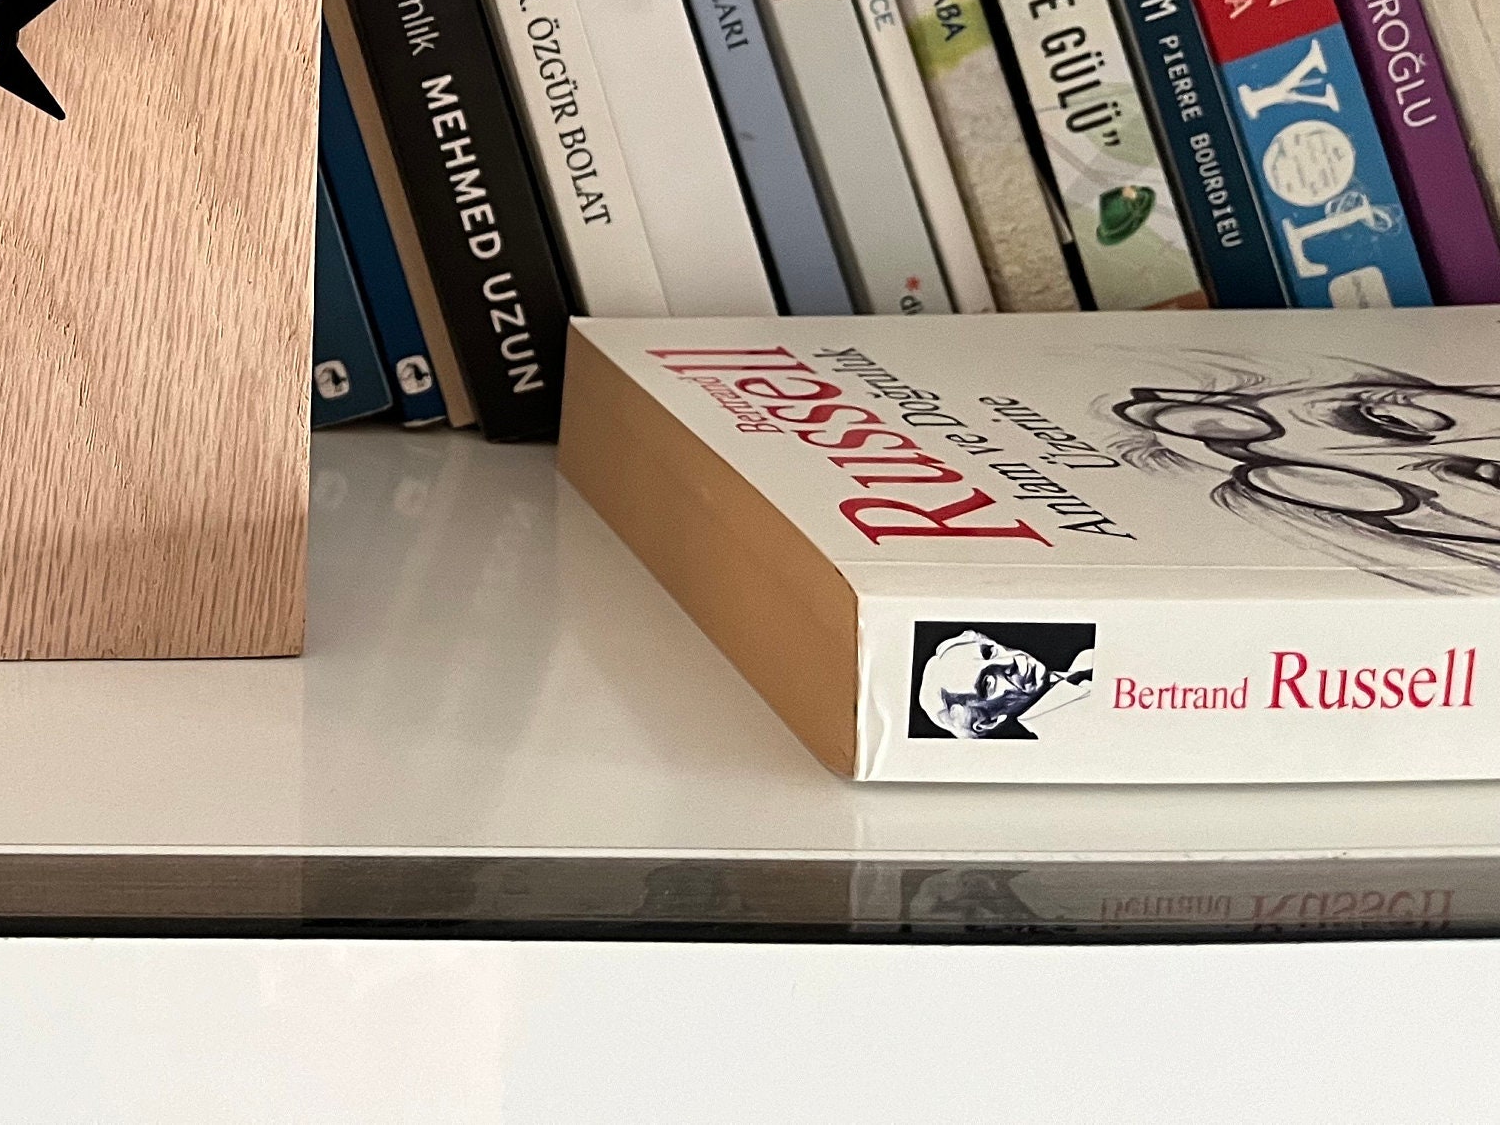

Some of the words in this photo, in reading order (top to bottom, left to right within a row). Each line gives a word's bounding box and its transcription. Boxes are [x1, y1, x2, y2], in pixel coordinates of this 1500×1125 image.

[527, 16, 580, 125] ÖZGÜR
[559, 126, 612, 225] BOLAT
[1159, 34, 1202, 123] PIERRE
[1190, 132, 1244, 250] BOURDIEU
[422, 74, 500, 261] MEHMED
[483, 274, 546, 394] UZUN
[682, 375, 786, 435] Bertrand
[812, 346, 969, 428] Doğruluk
[646, 346, 1053, 548] Russell
[945, 432, 1003, 455] ve
[979, 395, 1121, 470] Üzerine
[989, 462, 1137, 540] Anlam
[1112, 676, 1248, 711] Bertrand
[1266, 648, 1476, 710] Russell
